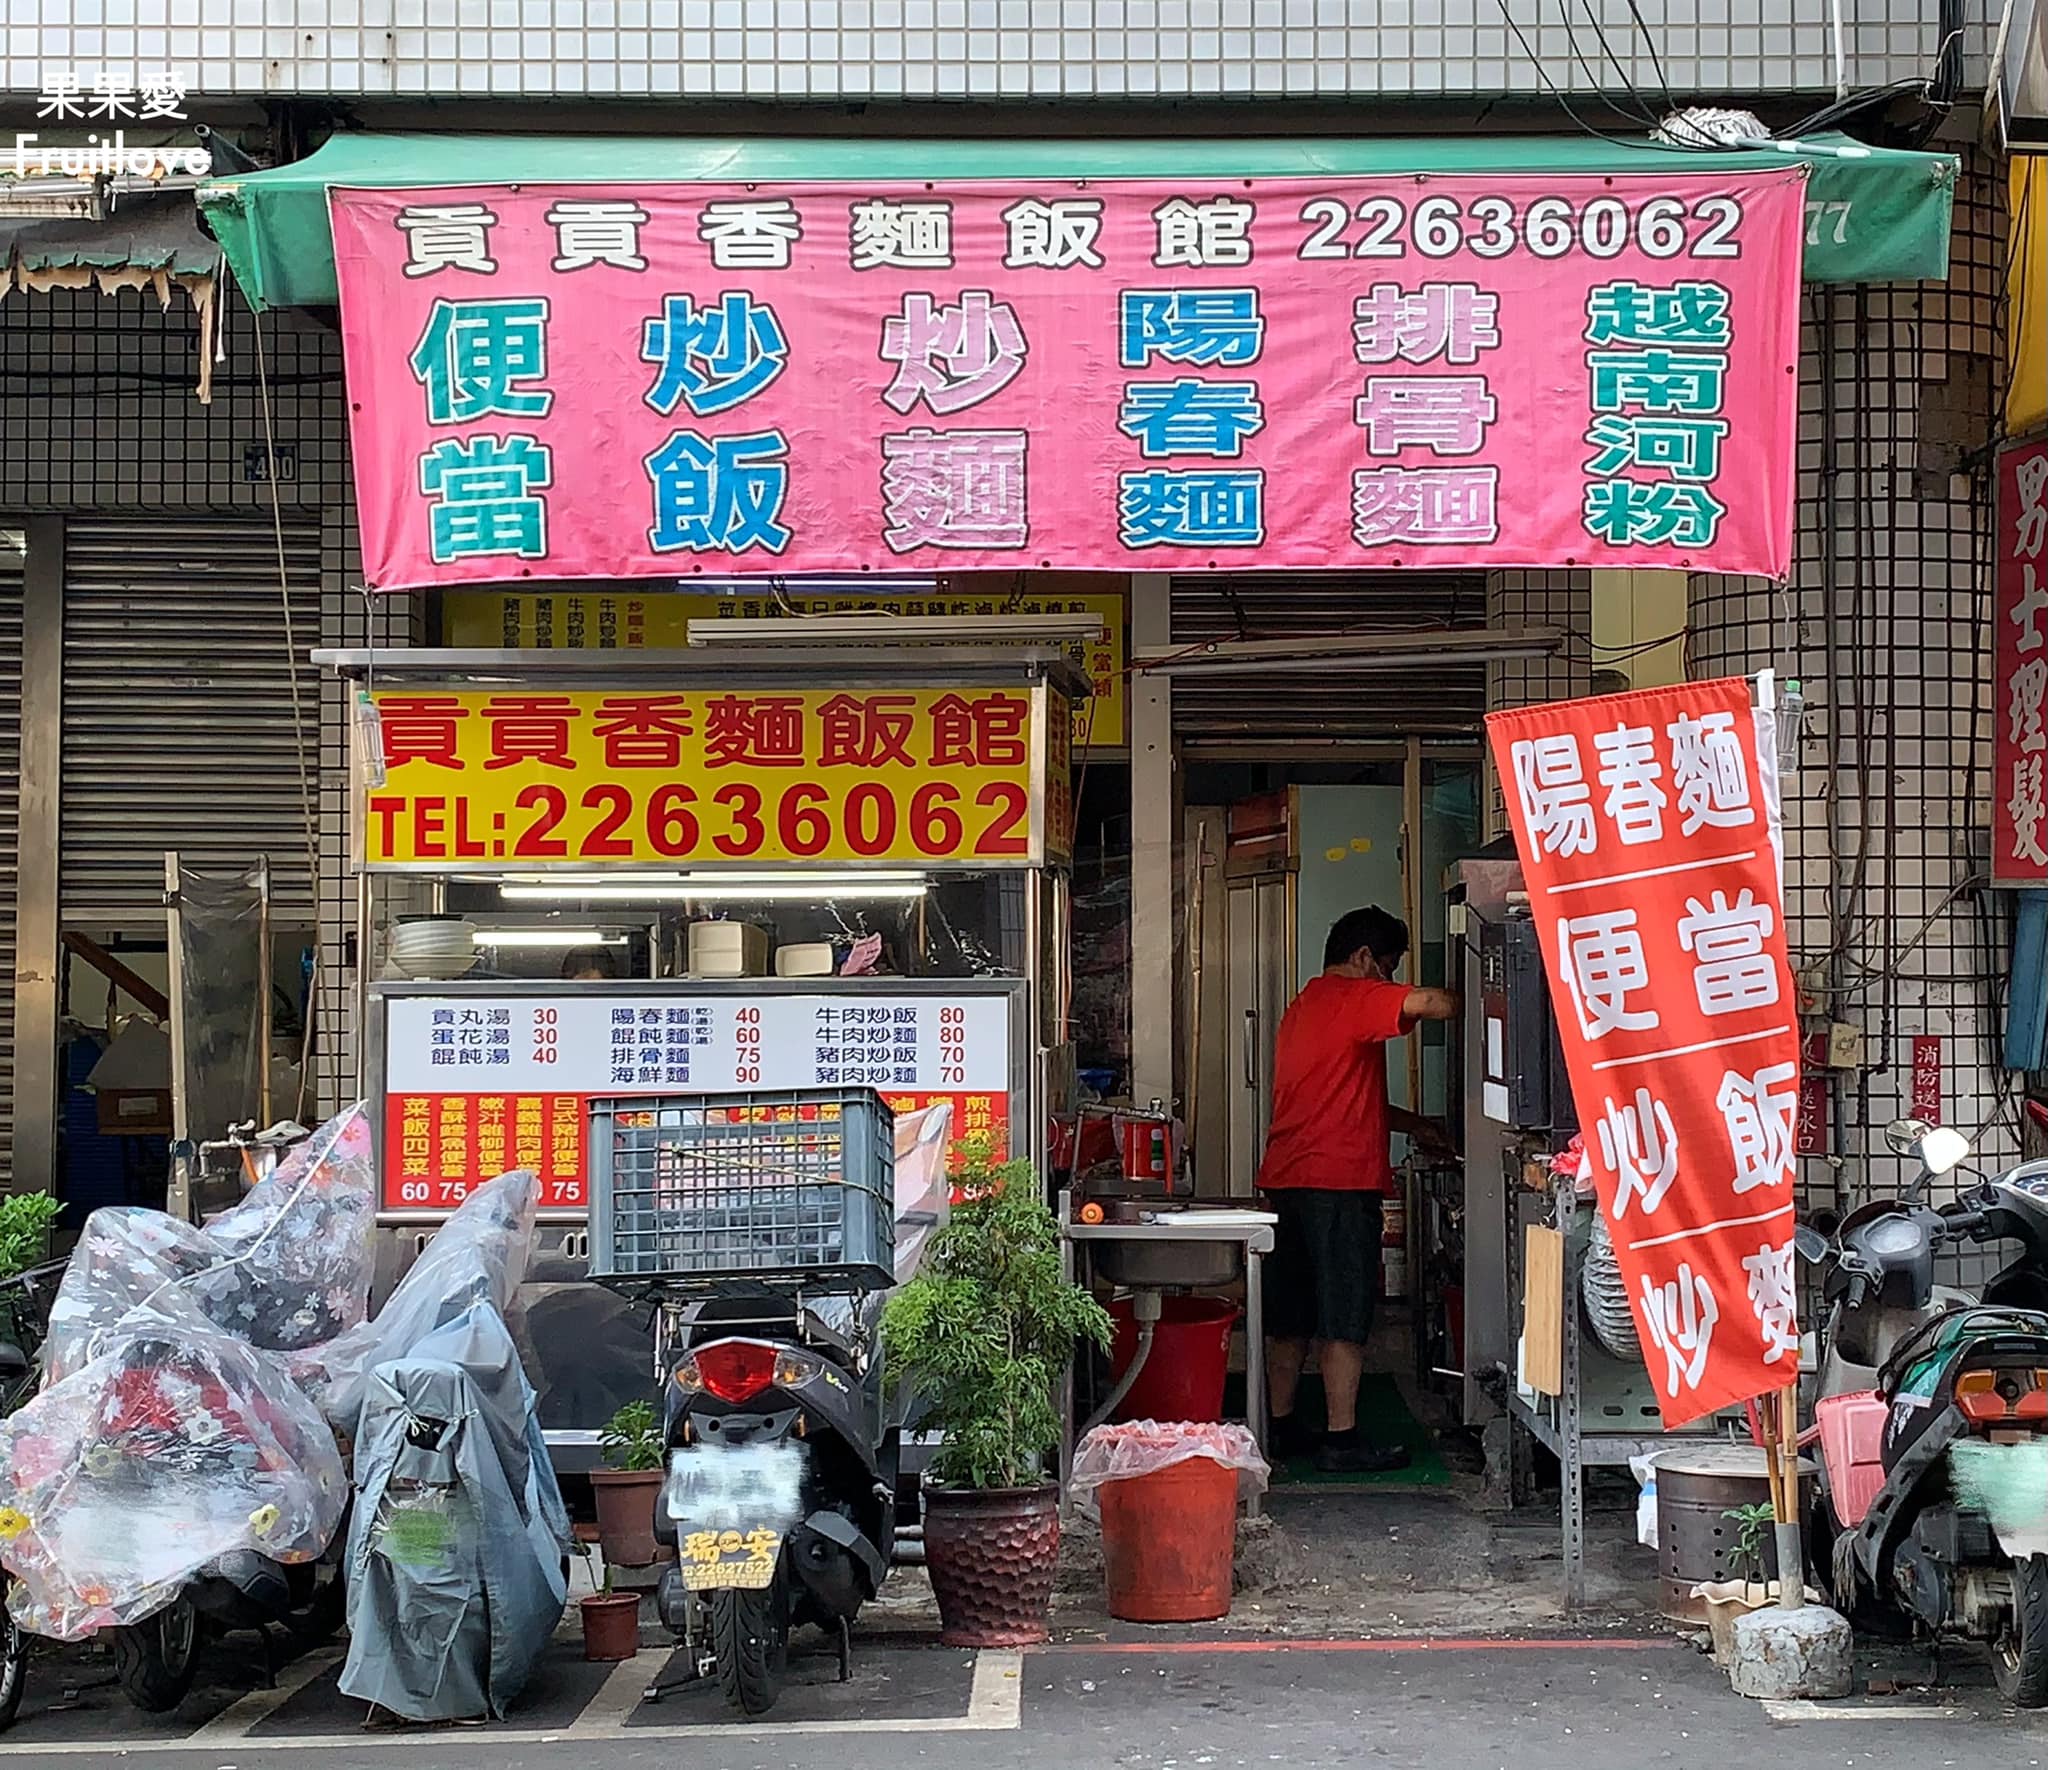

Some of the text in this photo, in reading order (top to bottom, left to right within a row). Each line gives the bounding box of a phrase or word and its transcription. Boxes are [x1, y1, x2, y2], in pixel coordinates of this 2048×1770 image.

[394, 195, 1742, 277] 貢貢香麵飯館 22636062
[409, 295, 555, 564] 便當
[641, 289, 793, 555] 炒飯
[880, 289, 1028, 553] 炒麵
[1117, 286, 1266, 549] 陽春麵
[1351, 281, 1502, 549] 排骨麵
[1583, 281, 1735, 549] 越南河粉
[2007, 455, 2048, 868] 男士理髮
[377, 693, 1029, 769] 貢貢香麵飯館
[1511, 711, 1756, 864] 陽春麵
[1557, 887, 1780, 1042] 便當
[431, 1008, 557, 1026] 貢丸湯 30
[431, 1028, 557, 1046] 蛋花湯 30
[611, 1008, 690, 1025] 陽春麵
[735, 1008, 760, 1024] 40
[611, 1028, 690, 1045] 餛飩麵
[735, 1027, 760, 1044] 60
[815, 1007, 964, 1024] 牛肉炒飯 80
[815, 1027, 964, 1044] 牛肉炒麵 80
[431, 1047, 557, 1065] 餛飩湯 40
[611, 1047, 760, 1065] 排骨麵 75
[611, 1066, 760, 1084] 海鮮麵 90
[815, 1046, 964, 1063] 豬肉炒飯 70
[815, 1066, 964, 1084] 豬肉炒麵 70
[401, 1098, 431, 1200] 菜飯四菜 60
[1596, 1061, 1798, 1220] 炒飯
[439, 1182, 466, 1200] 75
[552, 1182, 580, 1200] 75
